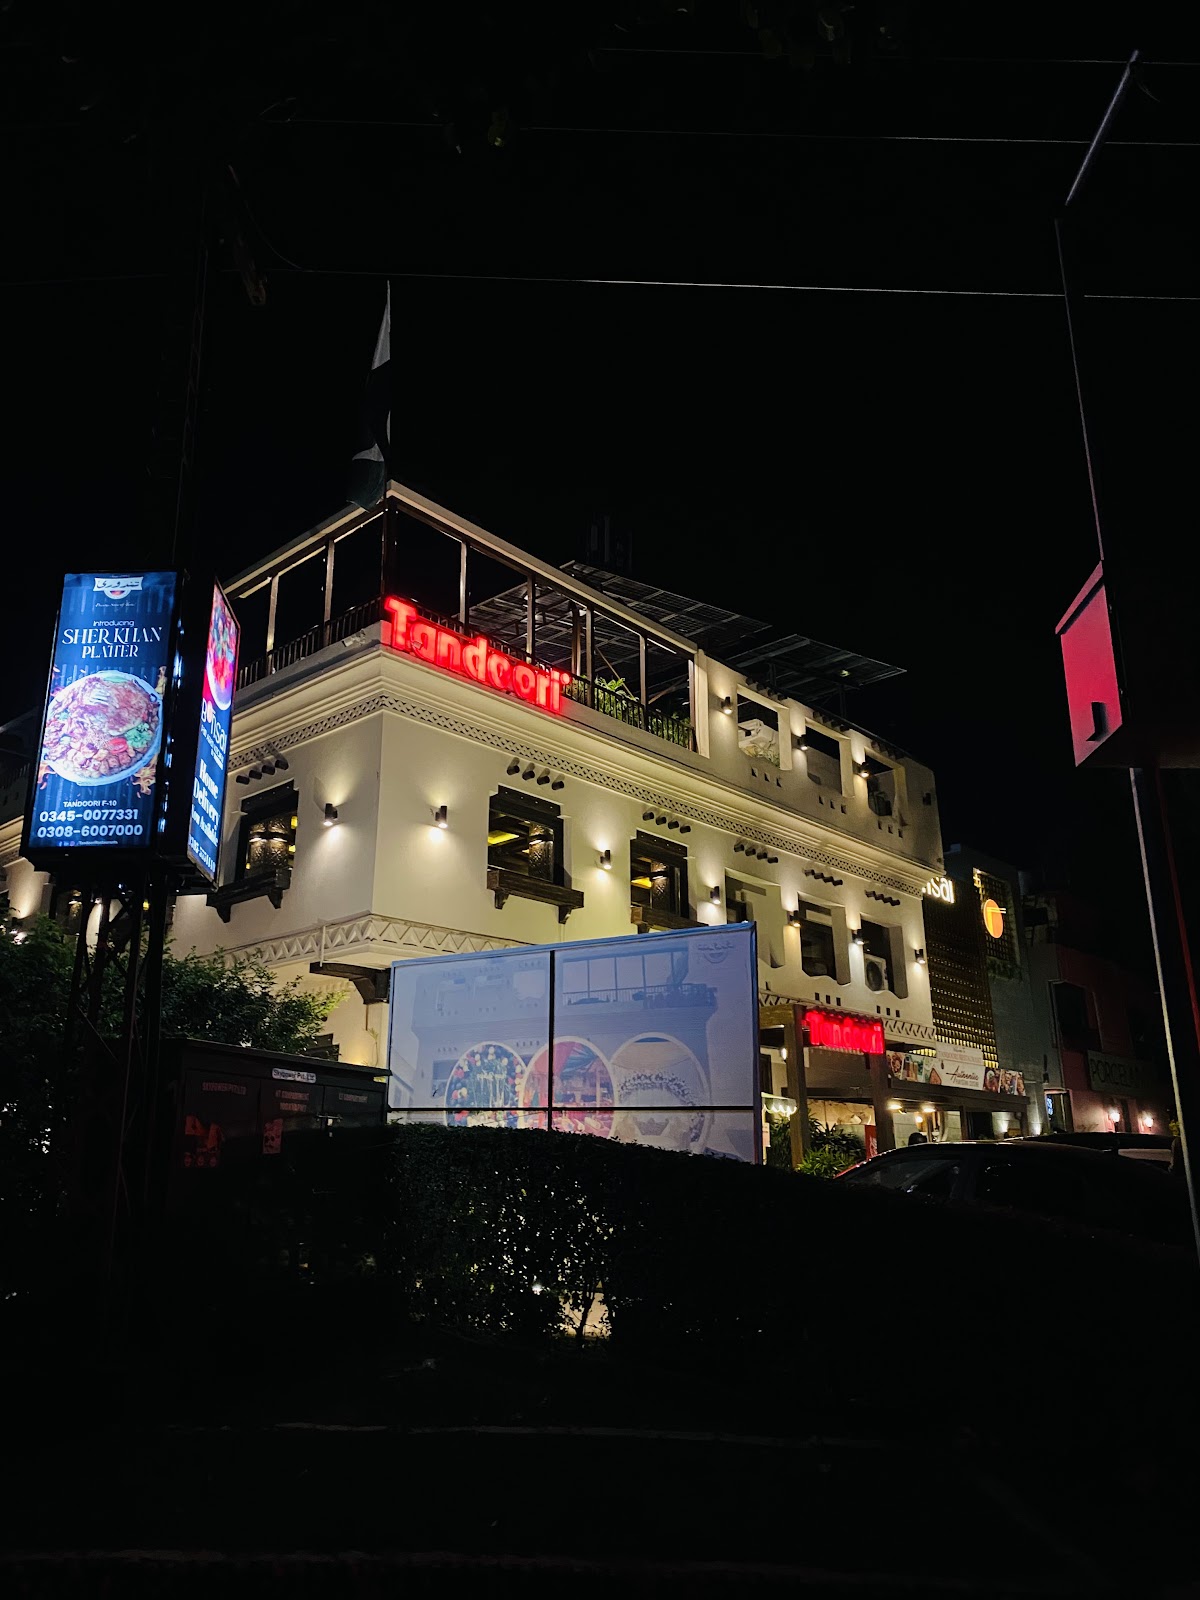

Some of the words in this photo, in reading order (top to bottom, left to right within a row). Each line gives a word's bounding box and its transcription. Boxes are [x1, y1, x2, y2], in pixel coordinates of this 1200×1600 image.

[93, 620, 135, 628] Introducing
[62, 627, 114, 646] SHER
[114, 626, 162, 644] KHAN
[82, 644, 138, 659] PLATTER
[385, 595, 562, 714] Tandoori
[199, 758, 218, 799] Home
[63, 800, 101, 808] TANDOORI
[193, 776, 220, 831] Delivery
[39, 809, 138, 822] 0345-0077331
[37, 824, 143, 838] 0308-6007000
